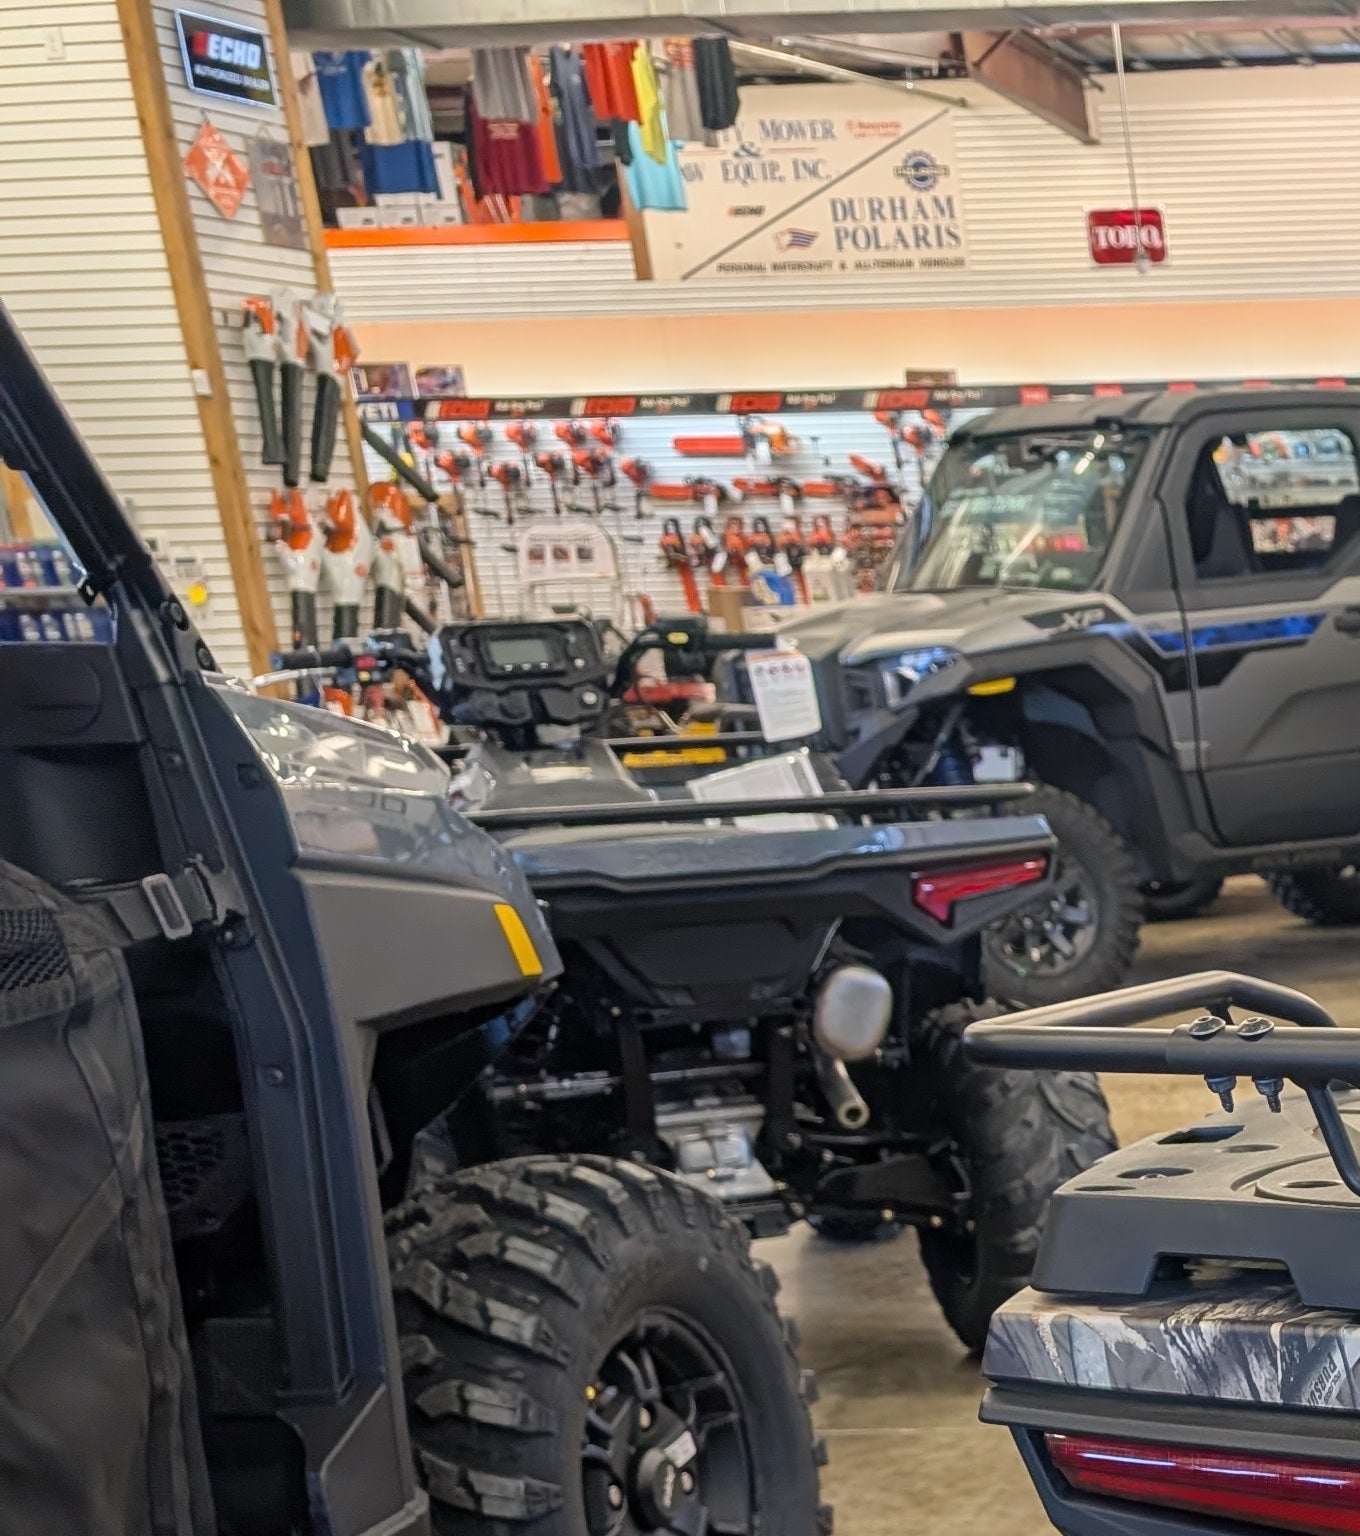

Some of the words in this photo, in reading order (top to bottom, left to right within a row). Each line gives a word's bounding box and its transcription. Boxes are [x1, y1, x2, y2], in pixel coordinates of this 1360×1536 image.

[208, 33, 261, 70] ECHO
[759, 119, 837, 142] MOWER
[733, 141, 762, 158] &
[793, 158, 833, 182] INC.
[830, 195, 957, 223] DURHAM
[834, 223, 962, 252] POLARIS
[1060, 608, 1106, 632] XP
